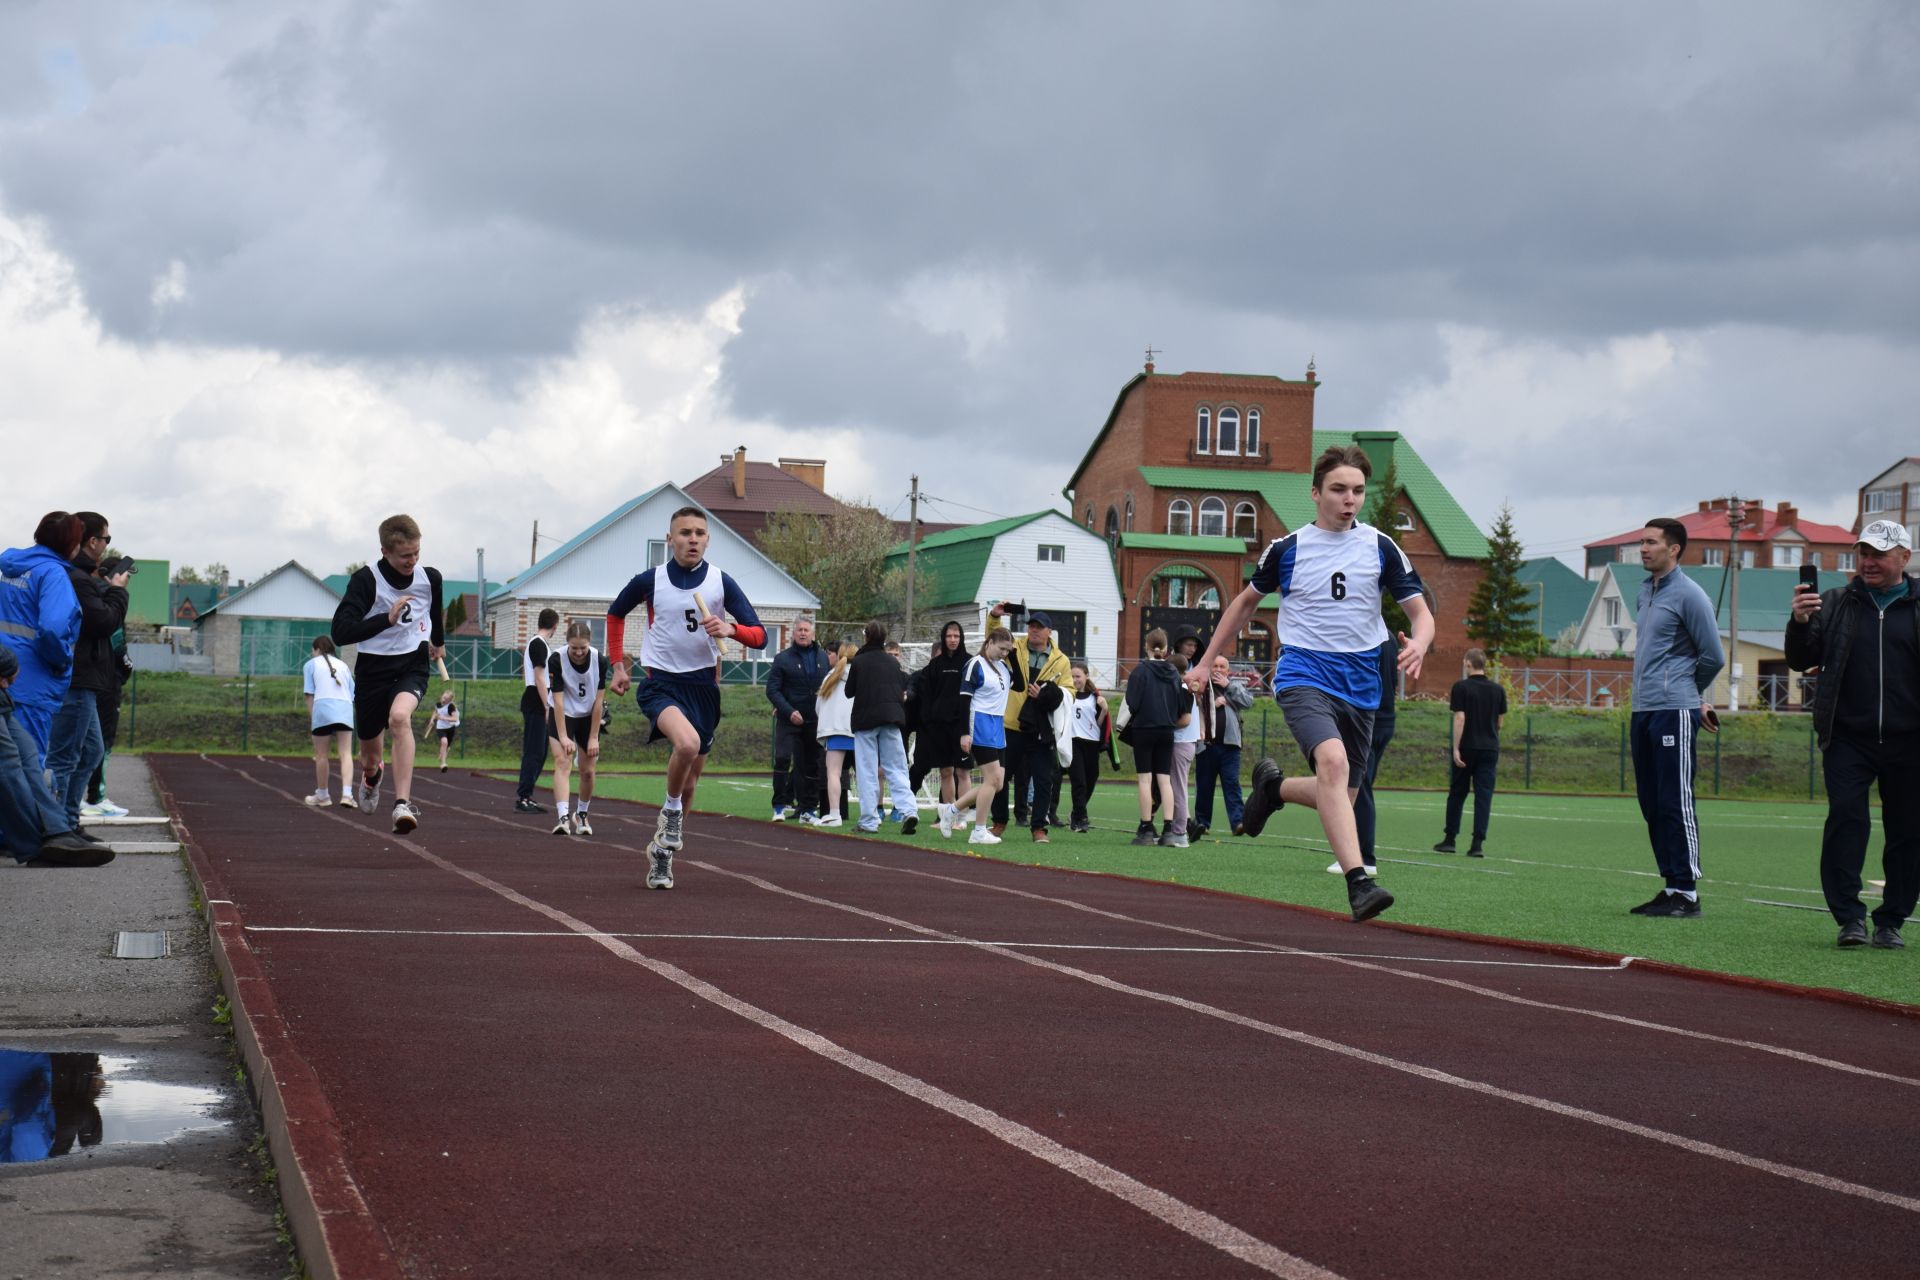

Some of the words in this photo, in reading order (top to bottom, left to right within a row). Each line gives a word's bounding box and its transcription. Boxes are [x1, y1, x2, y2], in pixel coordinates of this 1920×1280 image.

[1331, 571, 1346, 601] 6
[401, 601, 413, 624] 2
[685, 609, 698, 632] 5
[579, 683, 585, 697] 5
[1076, 708, 1081, 719] 5
